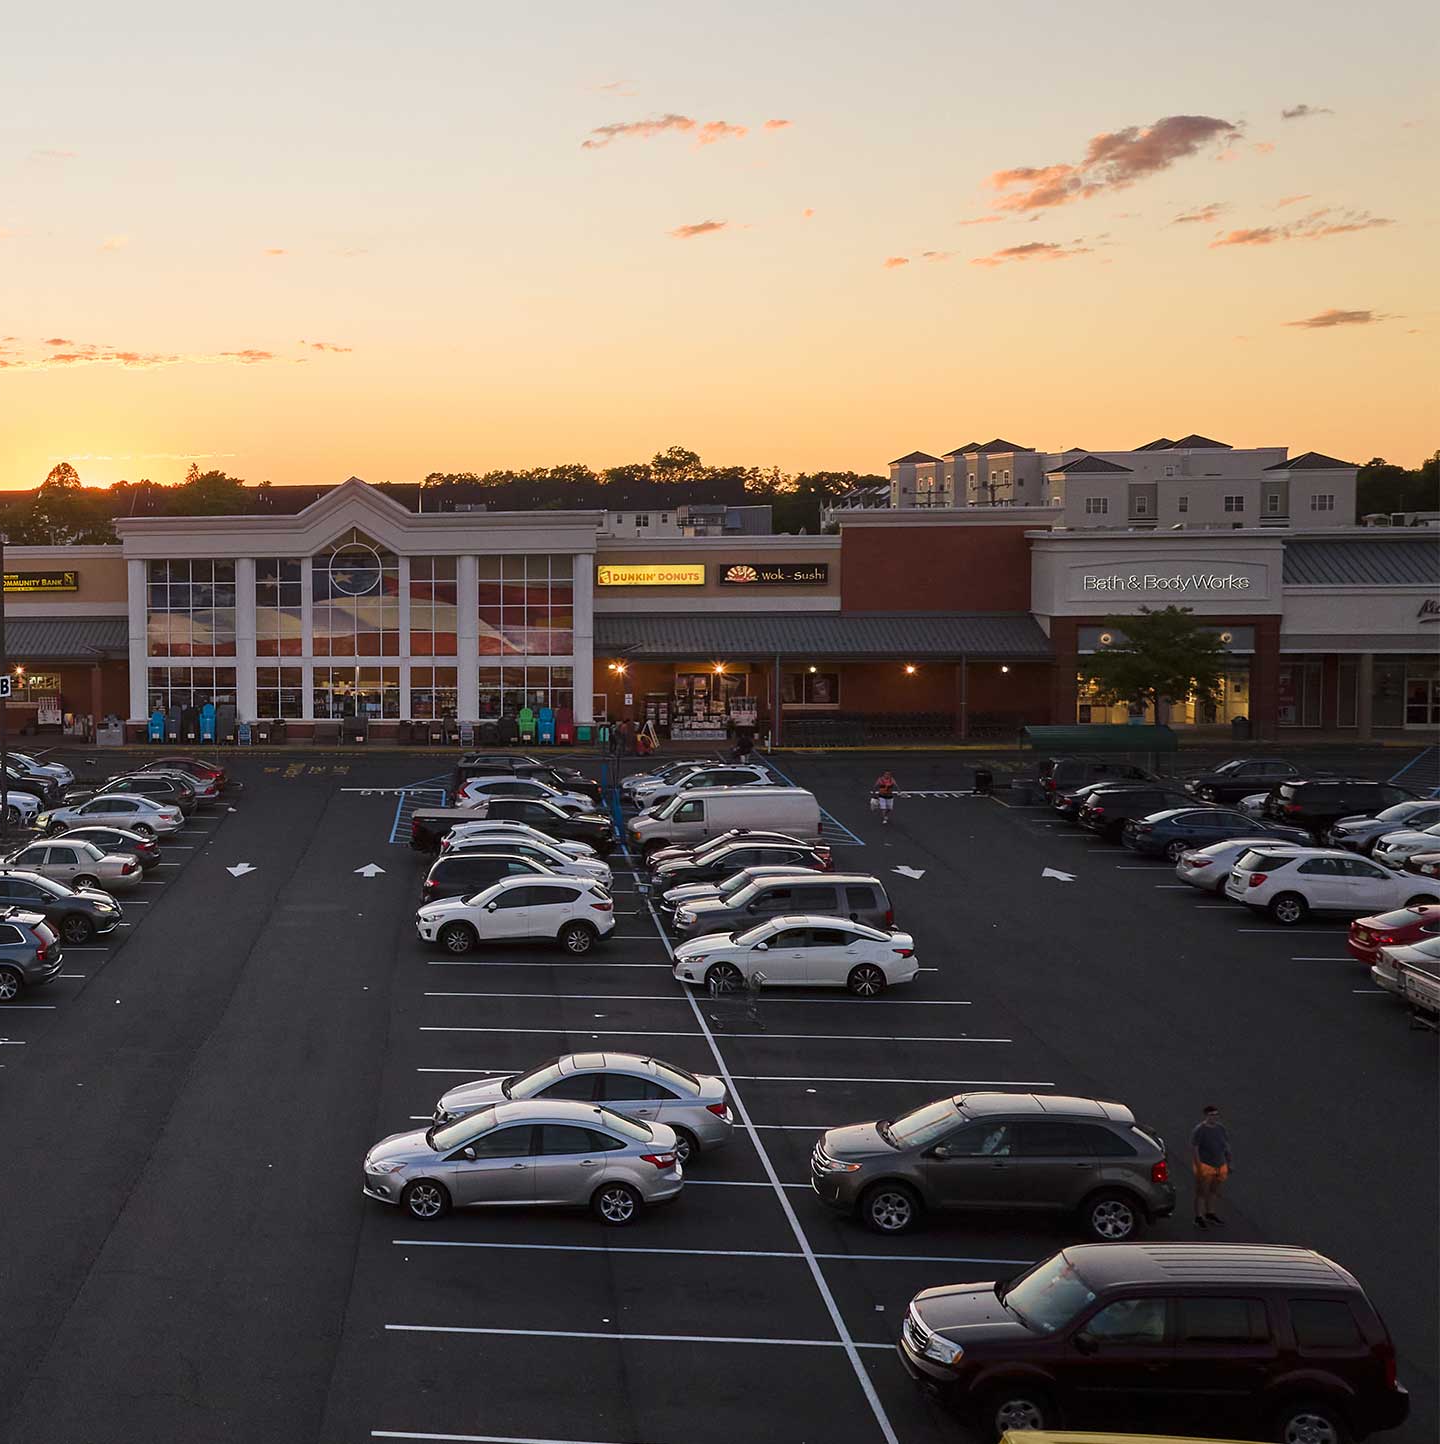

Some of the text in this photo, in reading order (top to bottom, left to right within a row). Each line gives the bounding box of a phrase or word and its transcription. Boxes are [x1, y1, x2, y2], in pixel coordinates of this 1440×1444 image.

[613, 573, 700, 582] DUNKIN' DONUTS
[793, 568, 825, 580] Sushi
[1083, 574, 1249, 592] Bath & Body Works
[1, 679, 9, 695] B
